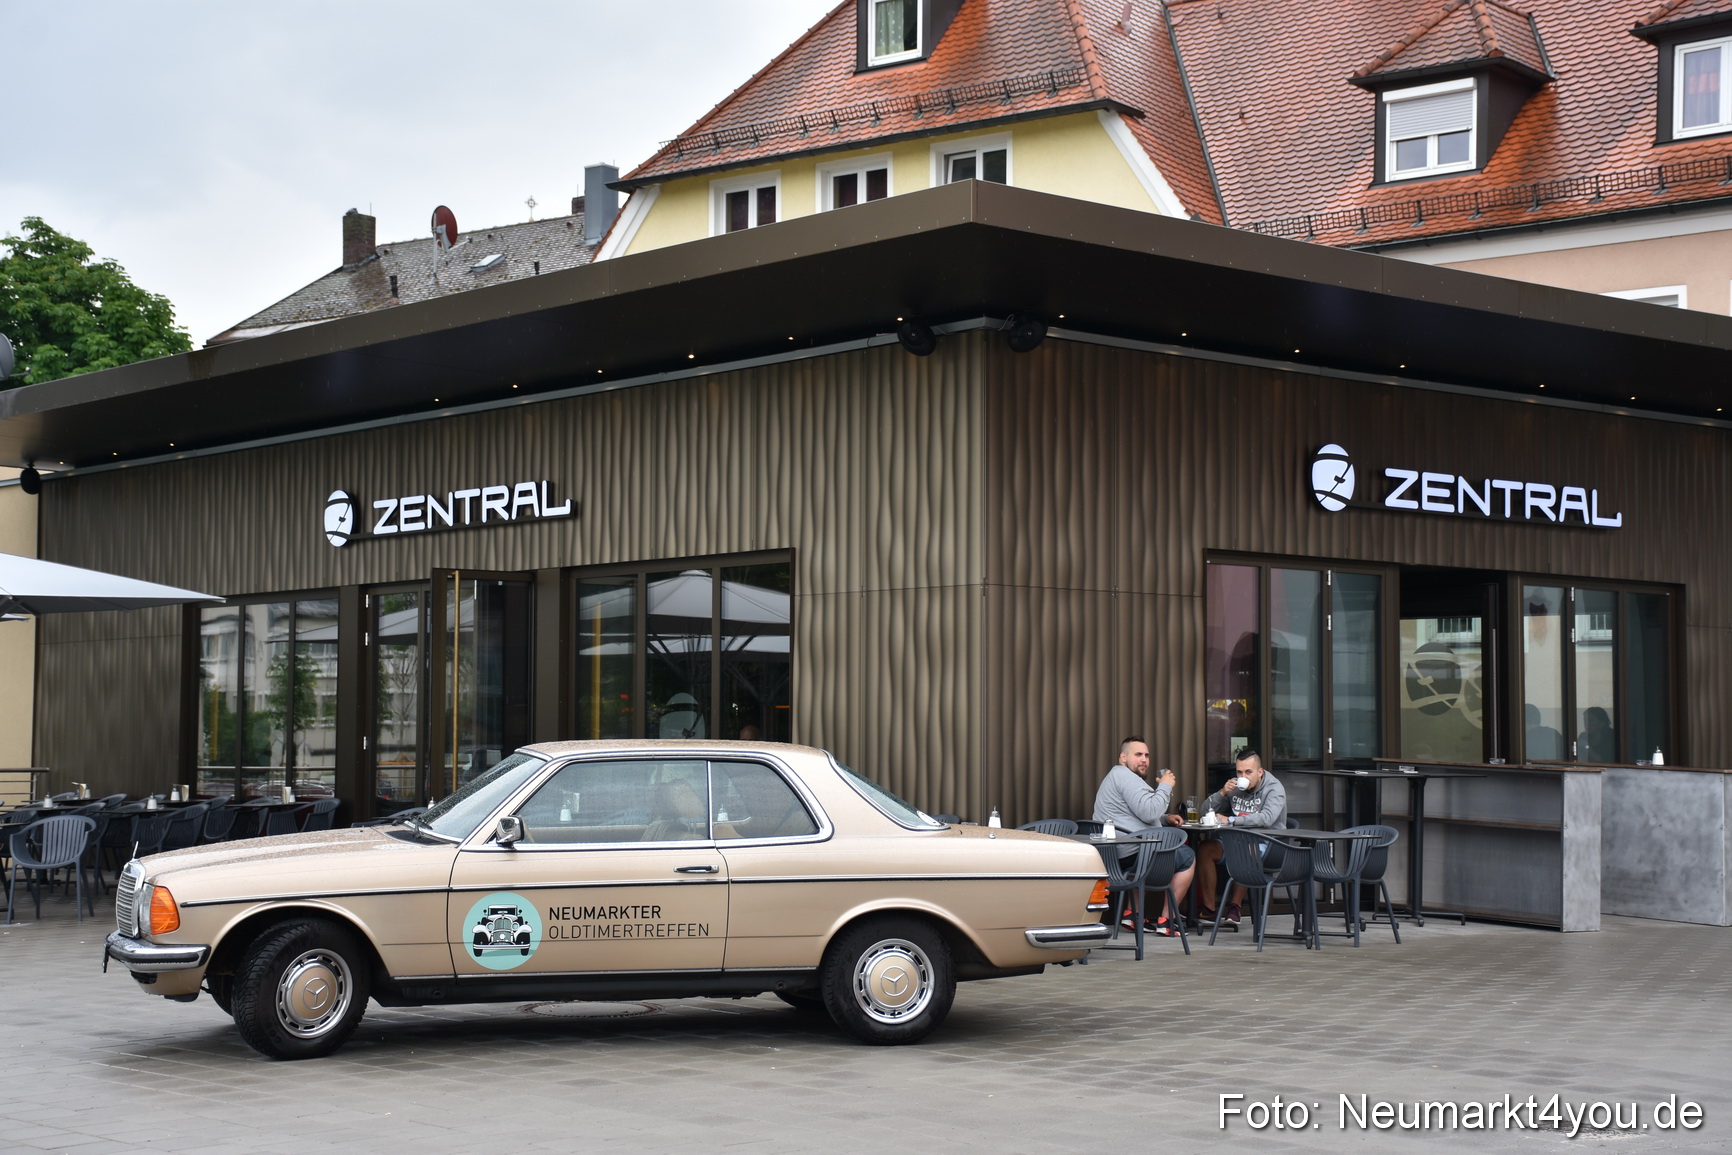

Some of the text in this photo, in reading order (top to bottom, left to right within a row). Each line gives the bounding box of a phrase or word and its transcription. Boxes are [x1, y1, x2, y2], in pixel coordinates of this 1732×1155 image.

[1384, 467, 1622, 528] ZENTRAL
[373, 479, 571, 535] ZENTRAL
[1232, 795, 1261, 807] CHICAO
[548, 905, 661, 921] NEUMARKTER
[548, 923, 710, 940] OLDTIMERTREFFEN
